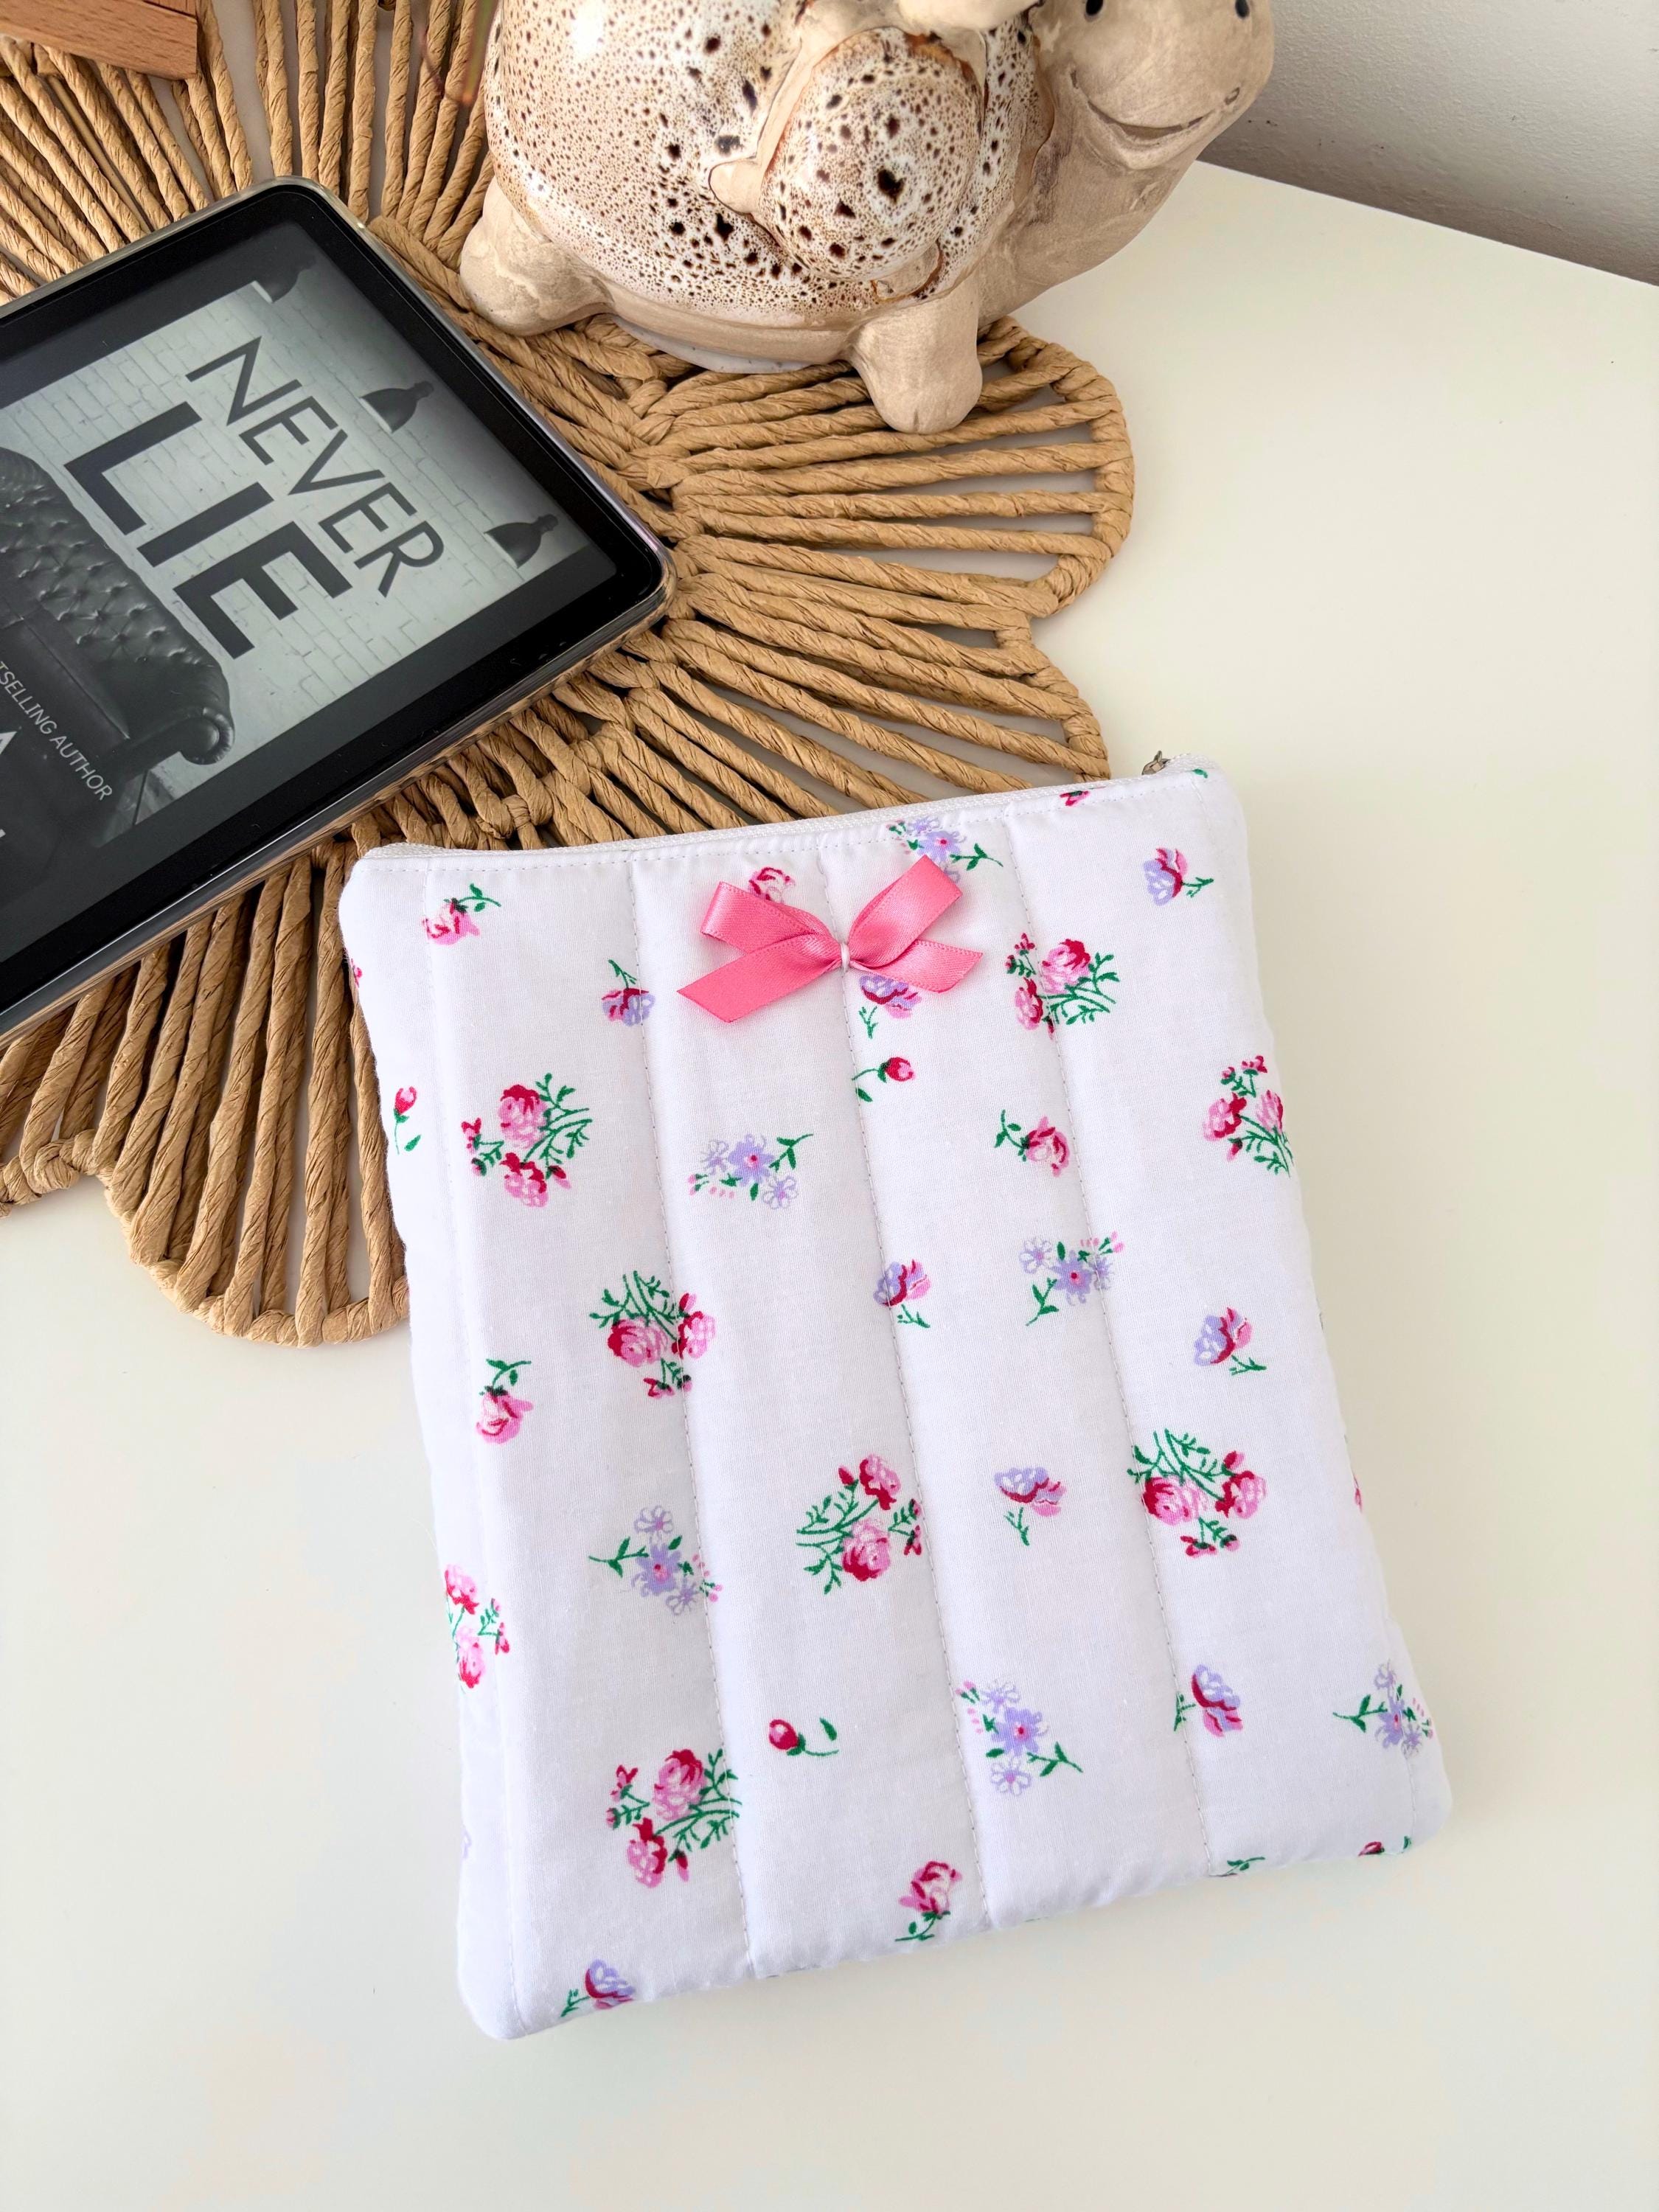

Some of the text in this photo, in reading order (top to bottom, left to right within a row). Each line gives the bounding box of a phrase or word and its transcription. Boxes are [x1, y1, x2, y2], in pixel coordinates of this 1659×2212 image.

[63, 402, 353, 659] LIE
[187, 336, 445, 598] NEVER
[49, 736, 112, 800] AUTHOR
